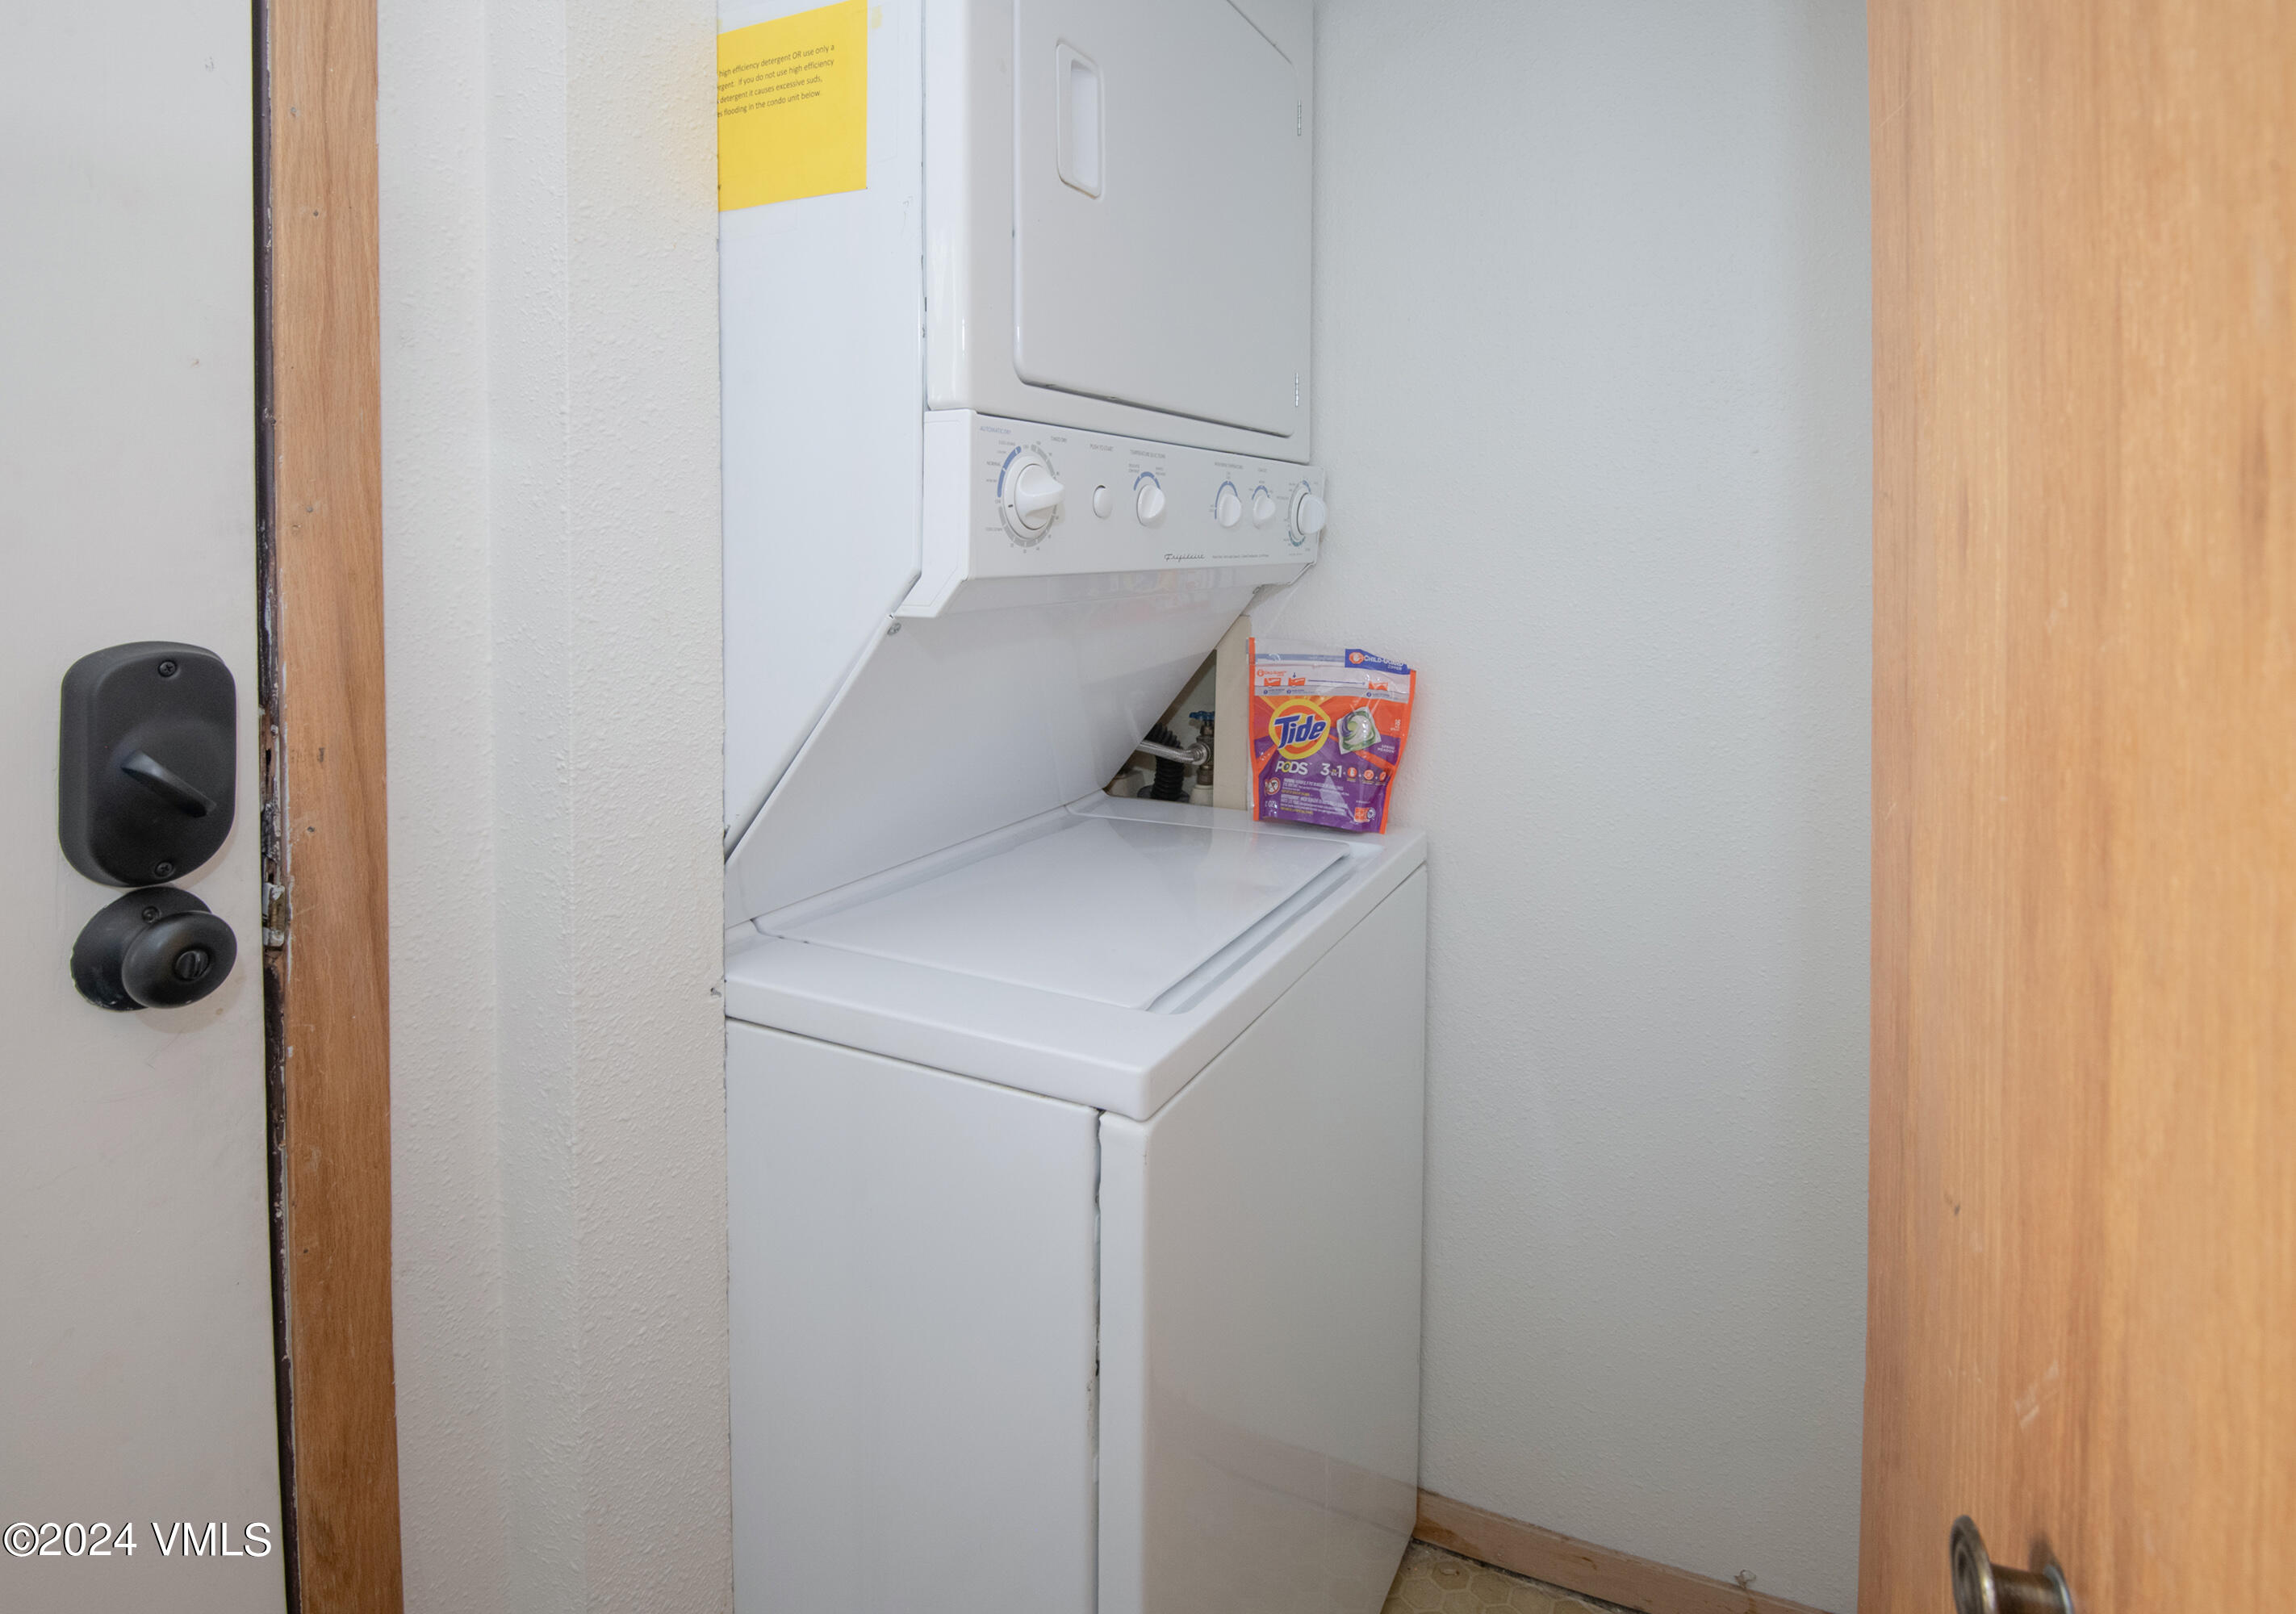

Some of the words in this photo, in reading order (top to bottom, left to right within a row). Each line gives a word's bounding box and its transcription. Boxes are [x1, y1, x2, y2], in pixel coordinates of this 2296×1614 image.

[719, 69, 731, 77] high
[733, 61, 760, 74] efficiency
[760, 55, 791, 66] detergent
[793, 52, 801, 60] OR
[803, 49, 814, 57] use
[815, 45, 829, 54] only
[765, 71, 775, 79] not
[788, 65, 802, 74] high
[804, 59, 834, 71] efficiency
[720, 90, 748, 103] detergent
[755, 86, 775, 95] causes
[776, 78, 805, 90] excessive
[724, 105, 747, 115] flooding
[767, 97, 786, 107] condo
[788, 94, 800, 102] unit
[801, 90, 821, 99] below
[1273, 713, 1326, 749] Tide
[1275, 760, 1308, 775] PODS
[1320, 763, 1330, 776] 3
[1337, 765, 1342, 778] 1
